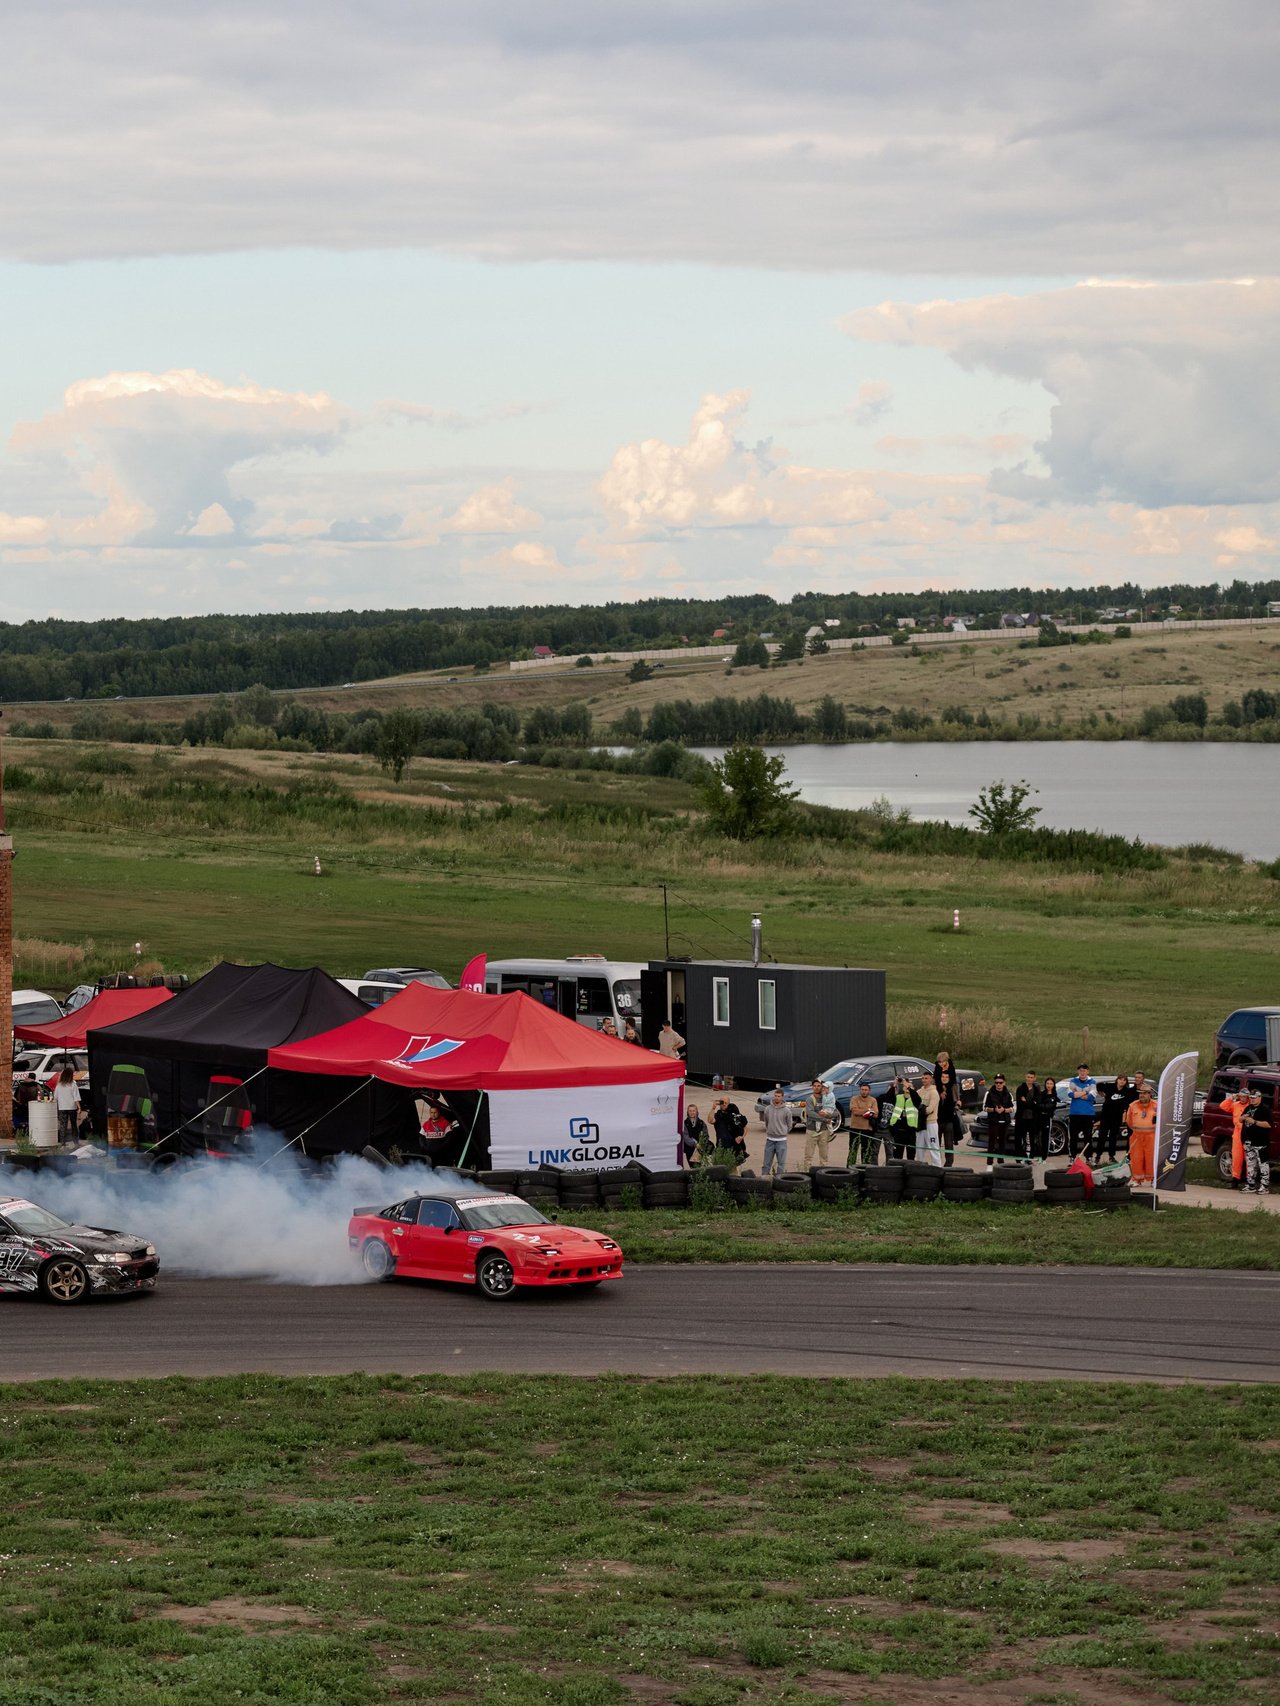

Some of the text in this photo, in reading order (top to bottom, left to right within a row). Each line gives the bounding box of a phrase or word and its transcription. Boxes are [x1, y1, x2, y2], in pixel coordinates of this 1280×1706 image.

[617, 993, 632, 1008] 36
[1172, 1076, 1181, 1122] СОВРЕМЕННАЯ
[1178, 1072, 1186, 1122] СТОМАТОЛОГИЯ
[528, 1144, 645, 1165] LINKGLOBAL
[1169, 1128, 1182, 1162] DENT
